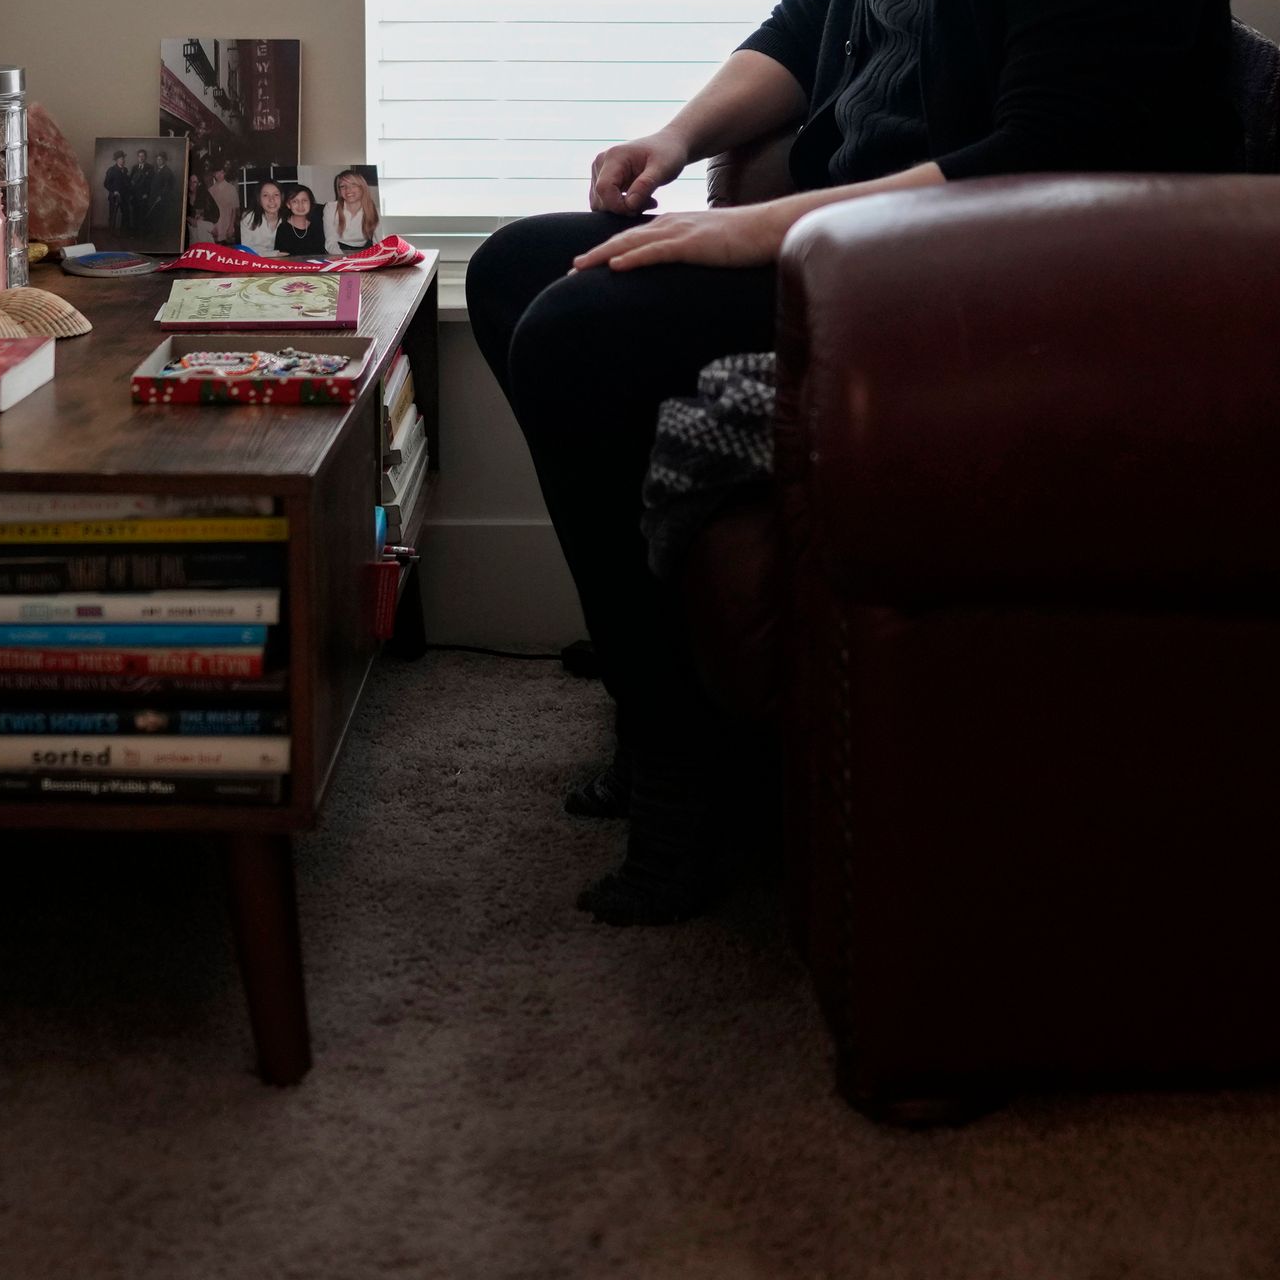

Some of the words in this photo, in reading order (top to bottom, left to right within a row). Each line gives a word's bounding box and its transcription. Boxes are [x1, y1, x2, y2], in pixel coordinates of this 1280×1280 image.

[180, 249, 217, 261] CITY
[217, 255, 250, 266] HALF
[252, 262, 322, 270] MARATHON
[77, 651, 124, 672] PRESS
[147, 653, 190, 674] MARK
[209, 654, 252, 675] LEVIN
[49, 711, 119, 733] HOWES
[31, 745, 112, 767] sorted
[41, 778, 100, 795] Becoming
[150, 780, 176, 793] Man
